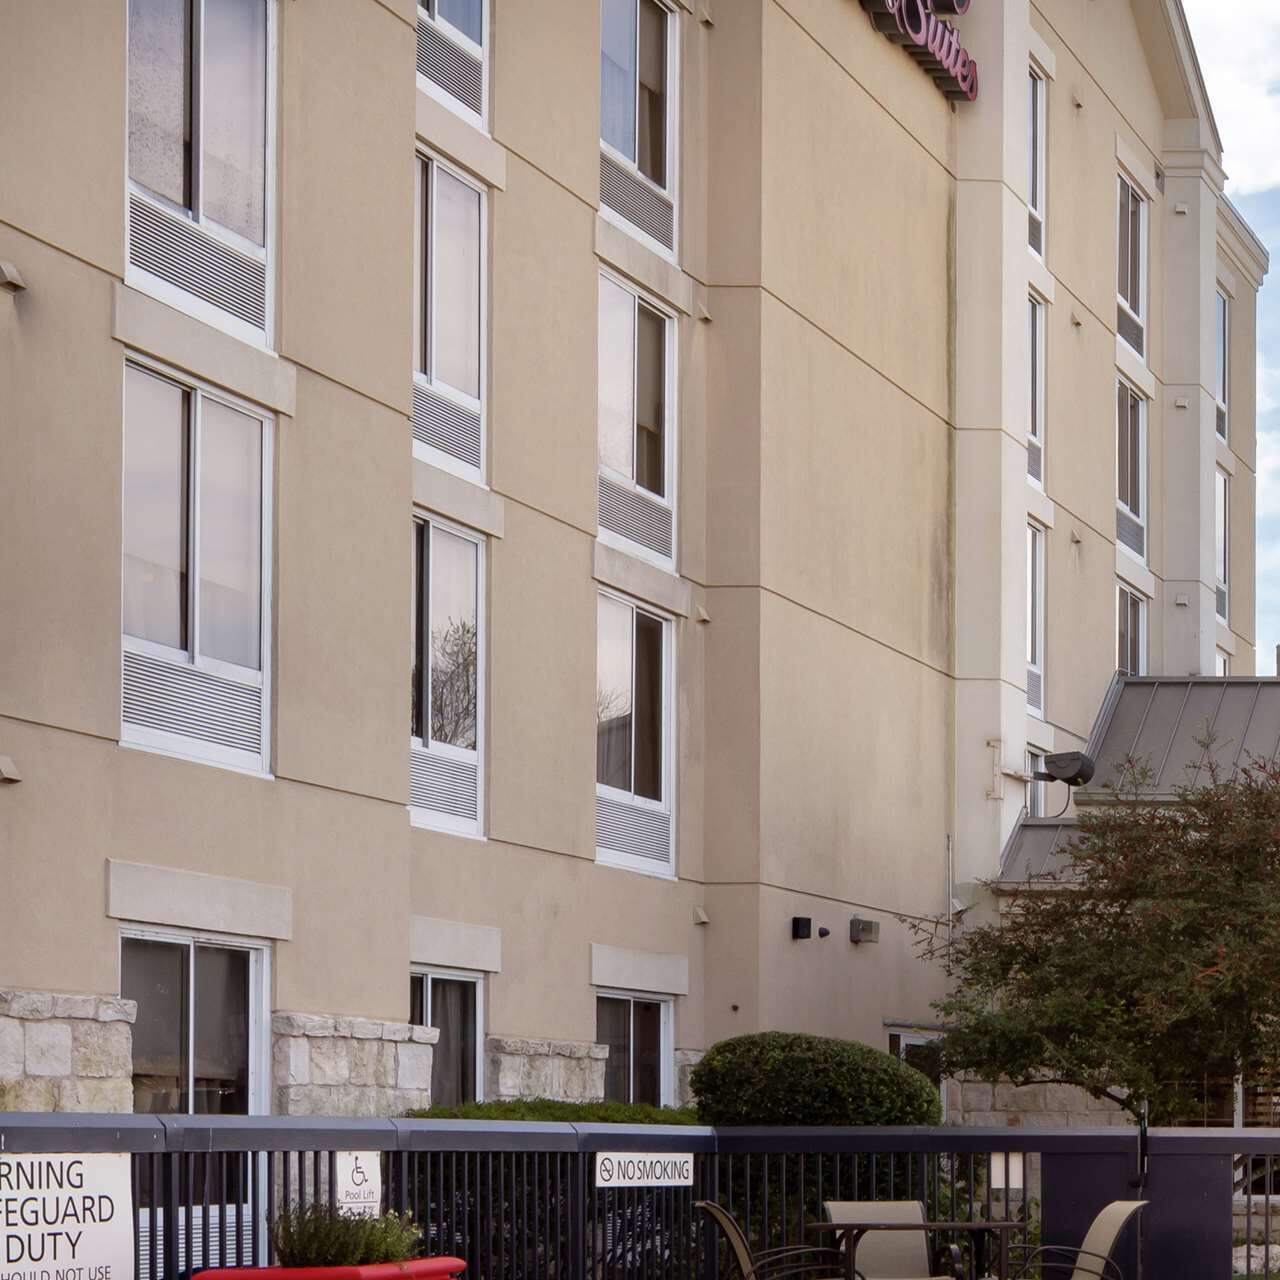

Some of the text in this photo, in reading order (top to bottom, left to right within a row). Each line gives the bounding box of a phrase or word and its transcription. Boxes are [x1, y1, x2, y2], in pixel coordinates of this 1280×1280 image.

[617, 1160, 689, 1180] NO SMOKING
[345, 1190, 361, 1200] Pool
[0, 1195, 115, 1226] EGUARD
[6, 1231, 82, 1264] DUTY
